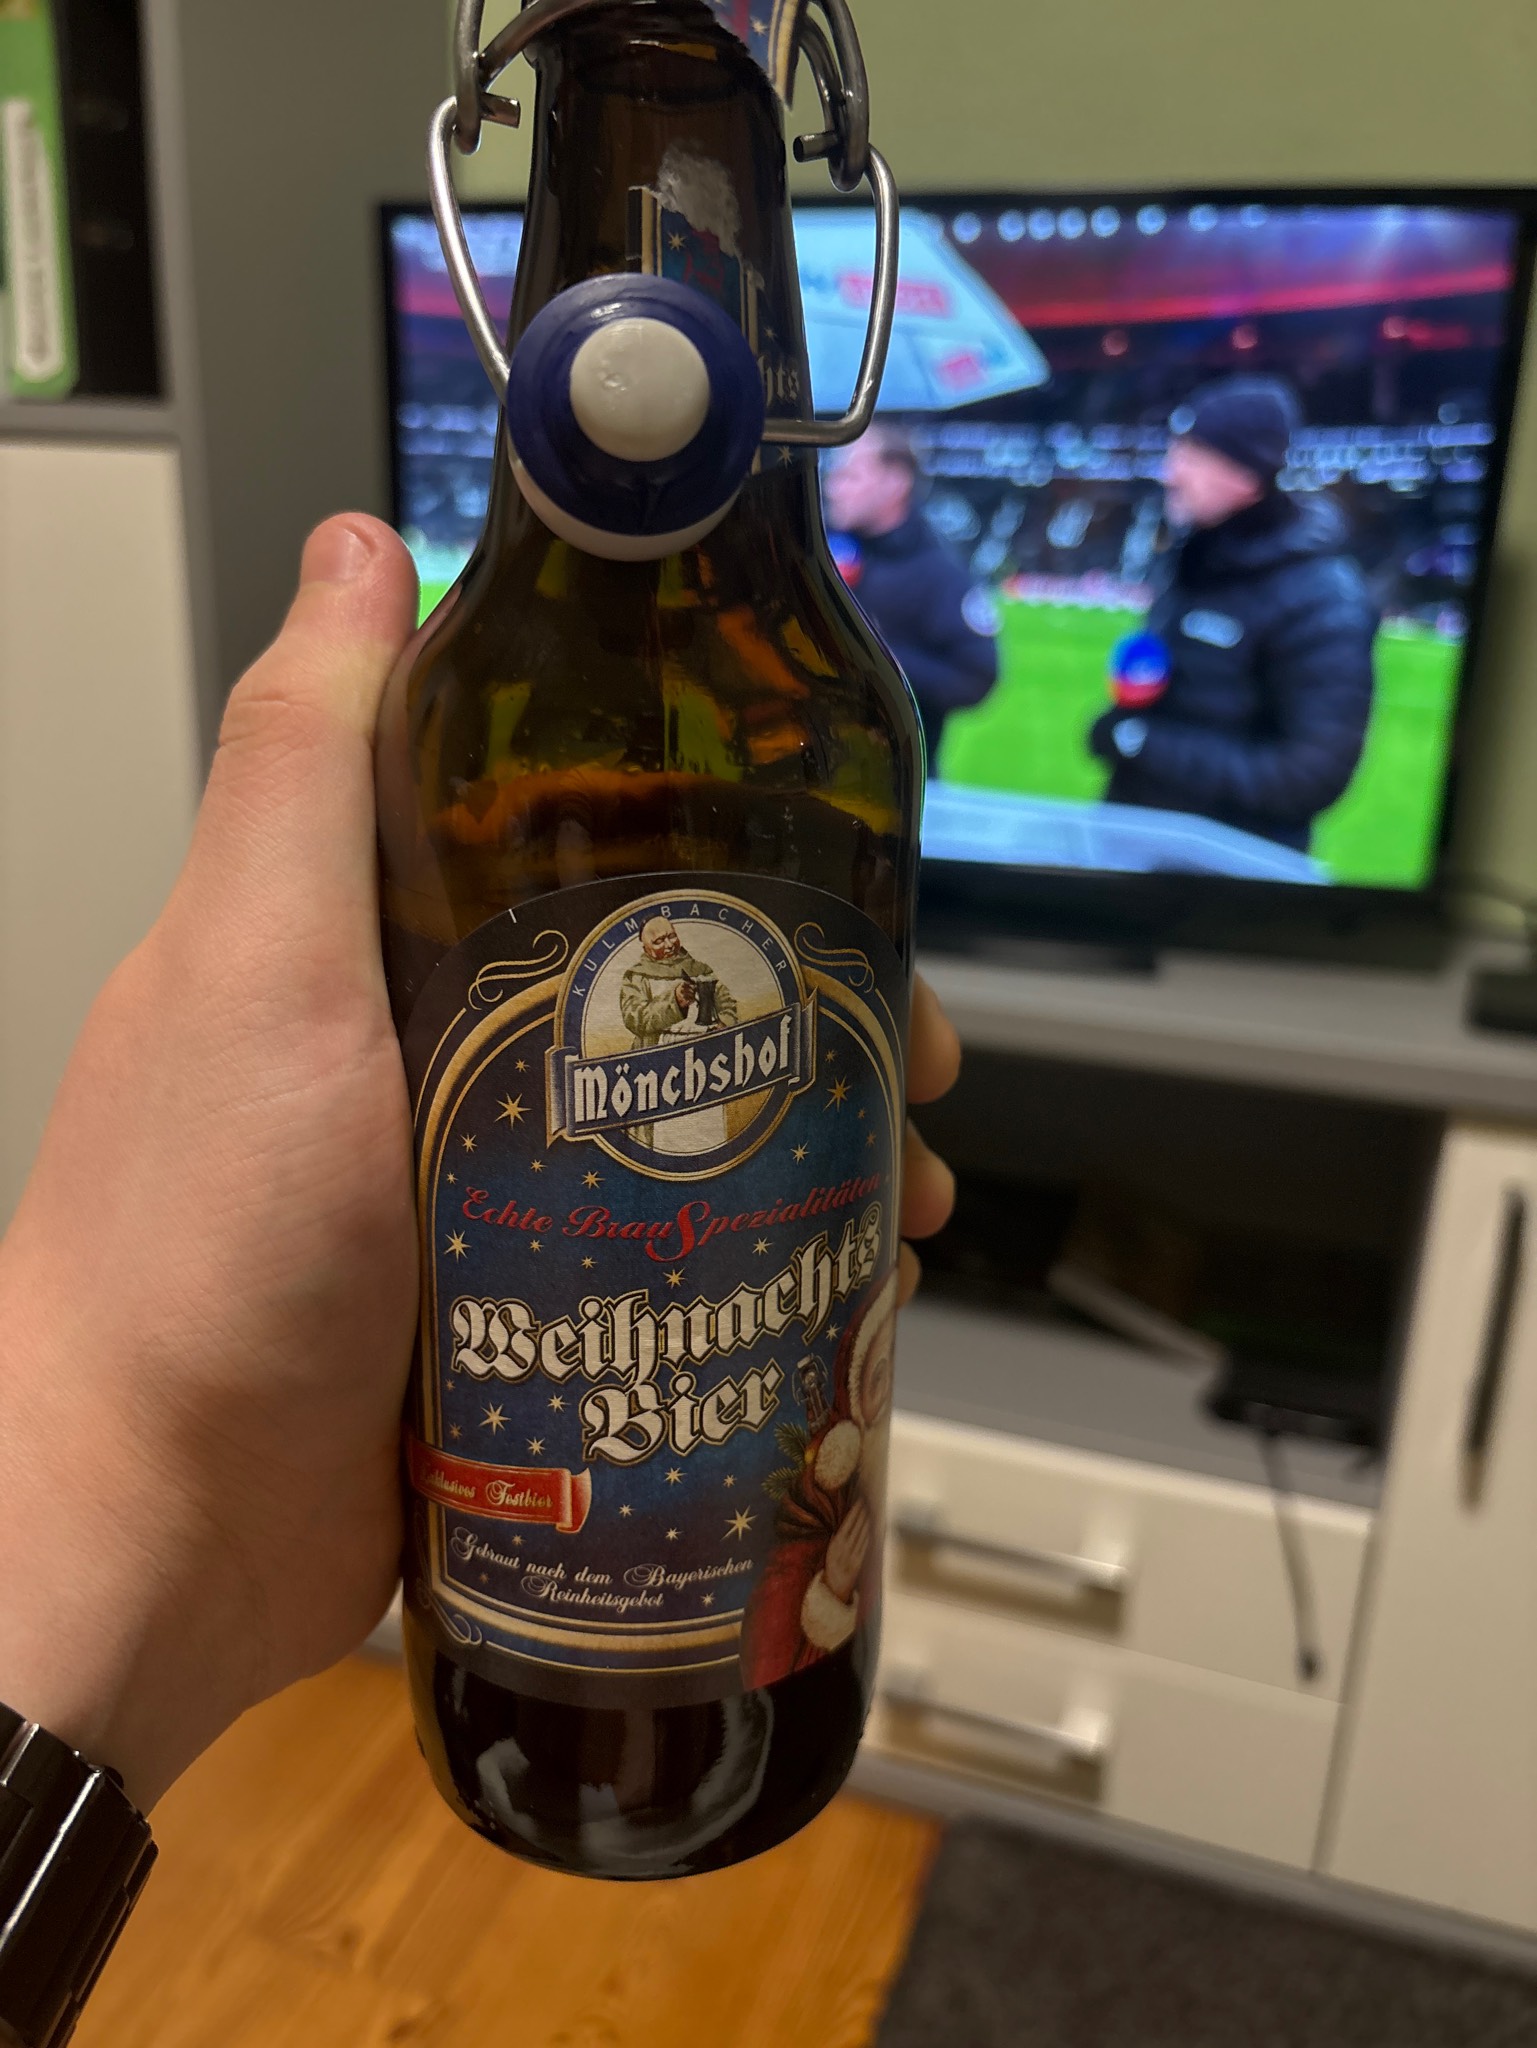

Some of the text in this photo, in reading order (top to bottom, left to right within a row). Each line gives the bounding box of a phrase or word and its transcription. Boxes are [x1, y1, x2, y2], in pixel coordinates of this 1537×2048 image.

[572, 903, 788, 997] KULMBACHER
[573, 1013, 794, 1123] Mönchshof
[462, 1186, 553, 1233] Echte
[451, 1201, 882, 1385] Weihnachts
[582, 1358, 783, 1466] Bier
[485, 1479, 553, 1508] Festbier
[451, 1527, 753, 1590] Gebraut nach dem Bayerischen
[521, 1575, 664, 1614] Reinheitsgebot
